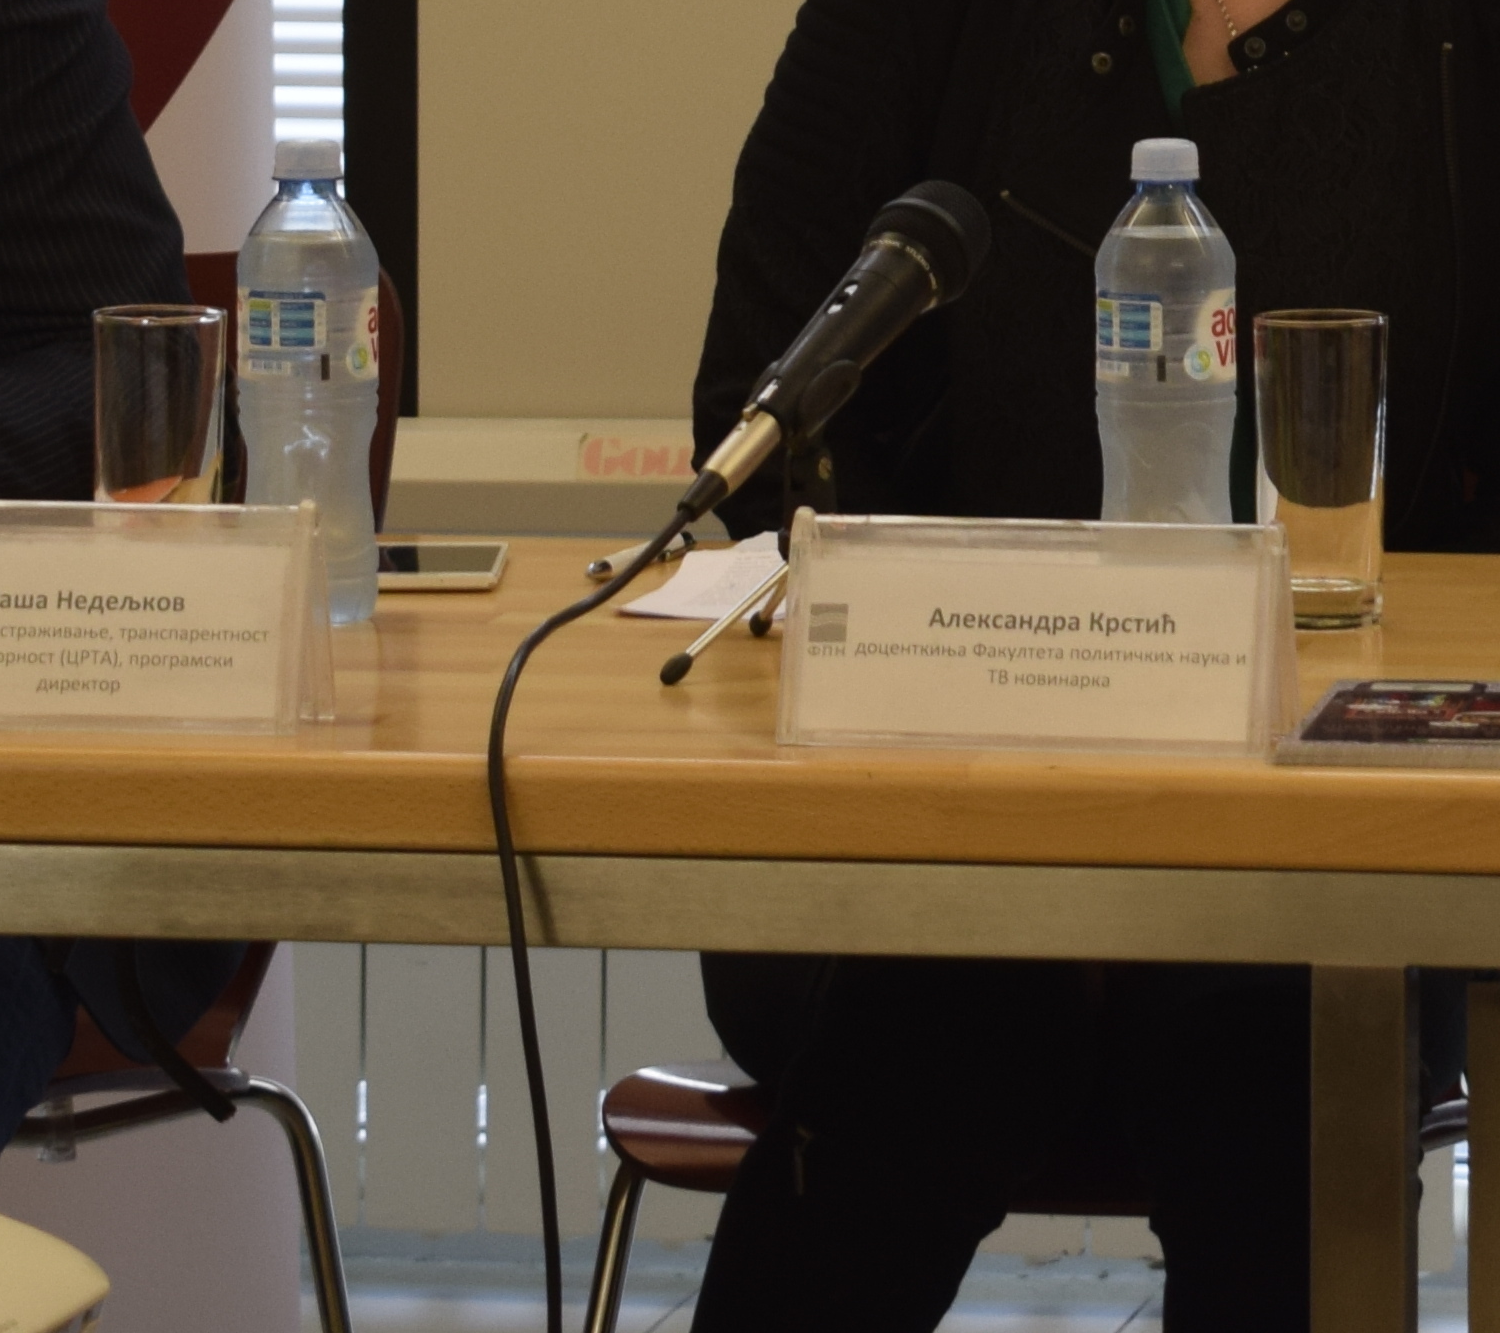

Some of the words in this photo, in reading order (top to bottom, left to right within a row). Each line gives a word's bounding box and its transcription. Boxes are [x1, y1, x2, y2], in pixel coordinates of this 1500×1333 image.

[56, 590, 185, 615] Недељков
[929, 607, 1081, 636] Александра
[1089, 611, 1176, 638] Крстић
[118, 627, 269, 647] транспарентност
[60, 649, 123, 671] (ЦРТА),
[129, 654, 232, 671] програмски
[807, 644, 846, 657] ФПН
[855, 642, 966, 660] доценткиња
[973, 643, 1064, 663] Факултета
[1070, 646, 1174, 665] политичких
[1179, 651, 1229, 668] наука
[1236, 653, 1246, 665] и
[36, 677, 120, 696] директор
[988, 669, 1008, 686] ТВ
[1014, 671, 1110, 691] новинарка
